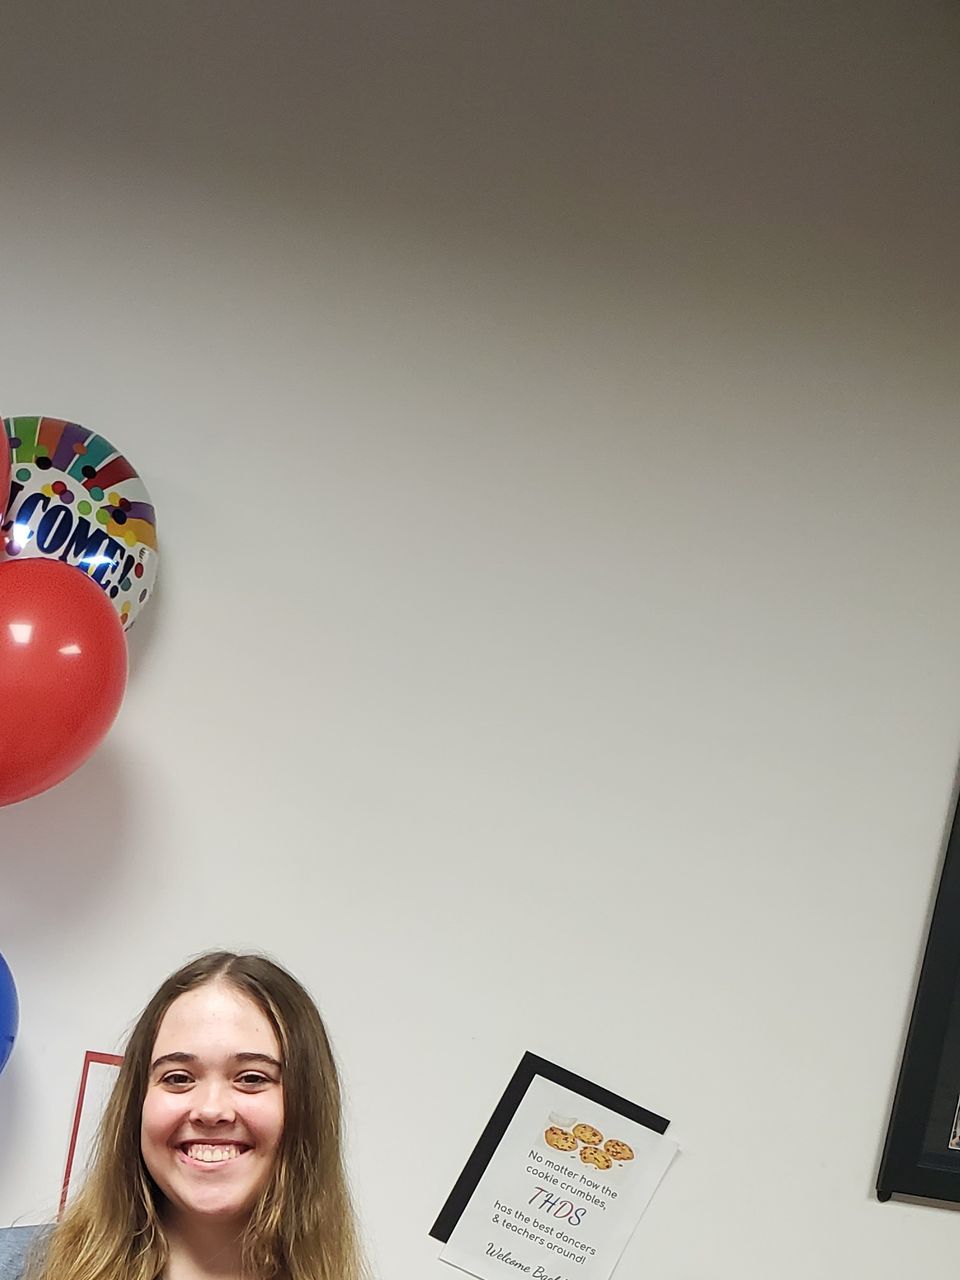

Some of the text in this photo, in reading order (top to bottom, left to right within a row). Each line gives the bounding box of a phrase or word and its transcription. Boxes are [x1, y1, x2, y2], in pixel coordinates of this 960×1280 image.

[3, 481, 135, 599] COME!
[526, 1165, 606, 1211] cookie crumbles,
[528, 1150, 618, 1200] No matter how the
[493, 1200, 597, 1256] has the best dancers
[528, 1186, 587, 1226] THDS
[485, 1242, 531, 1273] Welcome
[492, 1213, 587, 1265] & teachers around!
